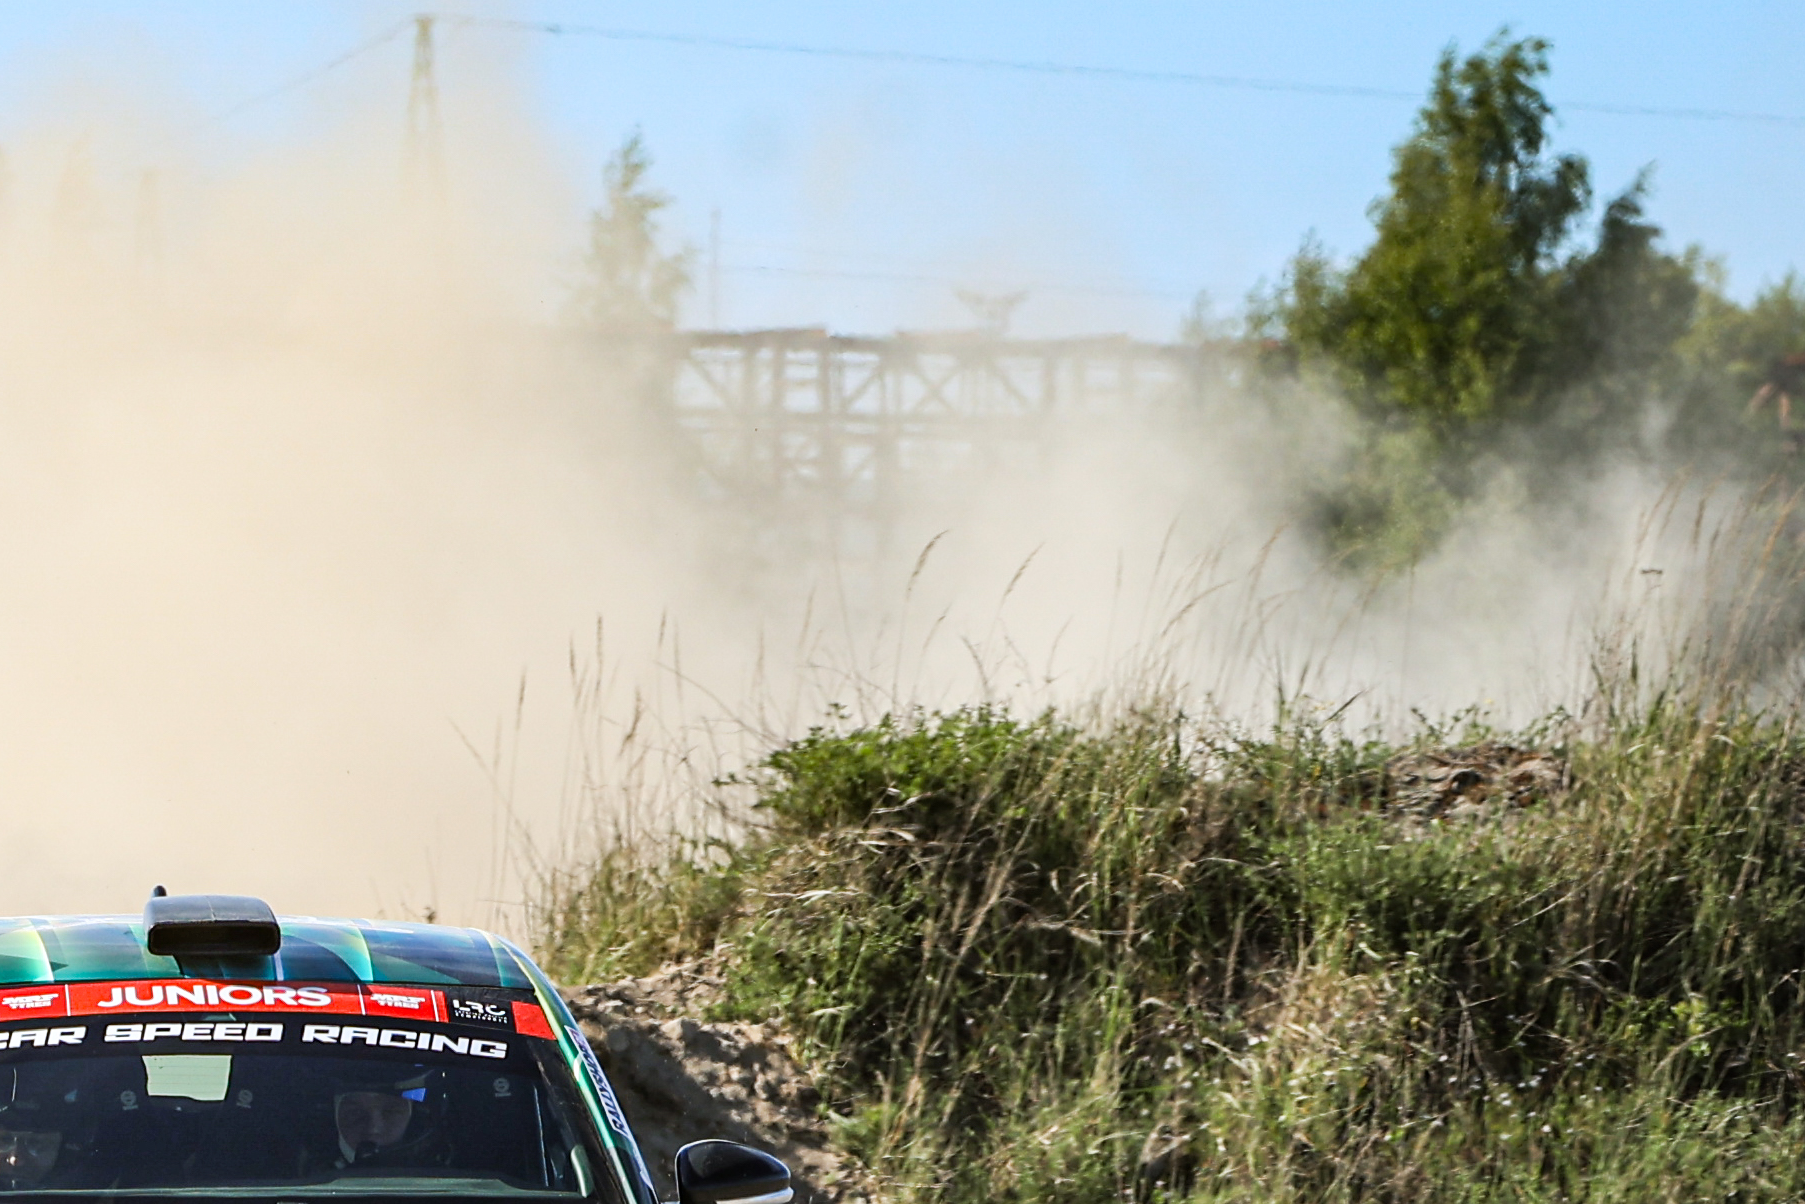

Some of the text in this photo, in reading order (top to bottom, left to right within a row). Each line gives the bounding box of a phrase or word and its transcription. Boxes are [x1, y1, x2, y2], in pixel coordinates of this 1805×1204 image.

[97, 985, 333, 1010] JUNIORS
[104, 1022, 283, 1043] SPEED
[302, 1024, 508, 1060] RACING
